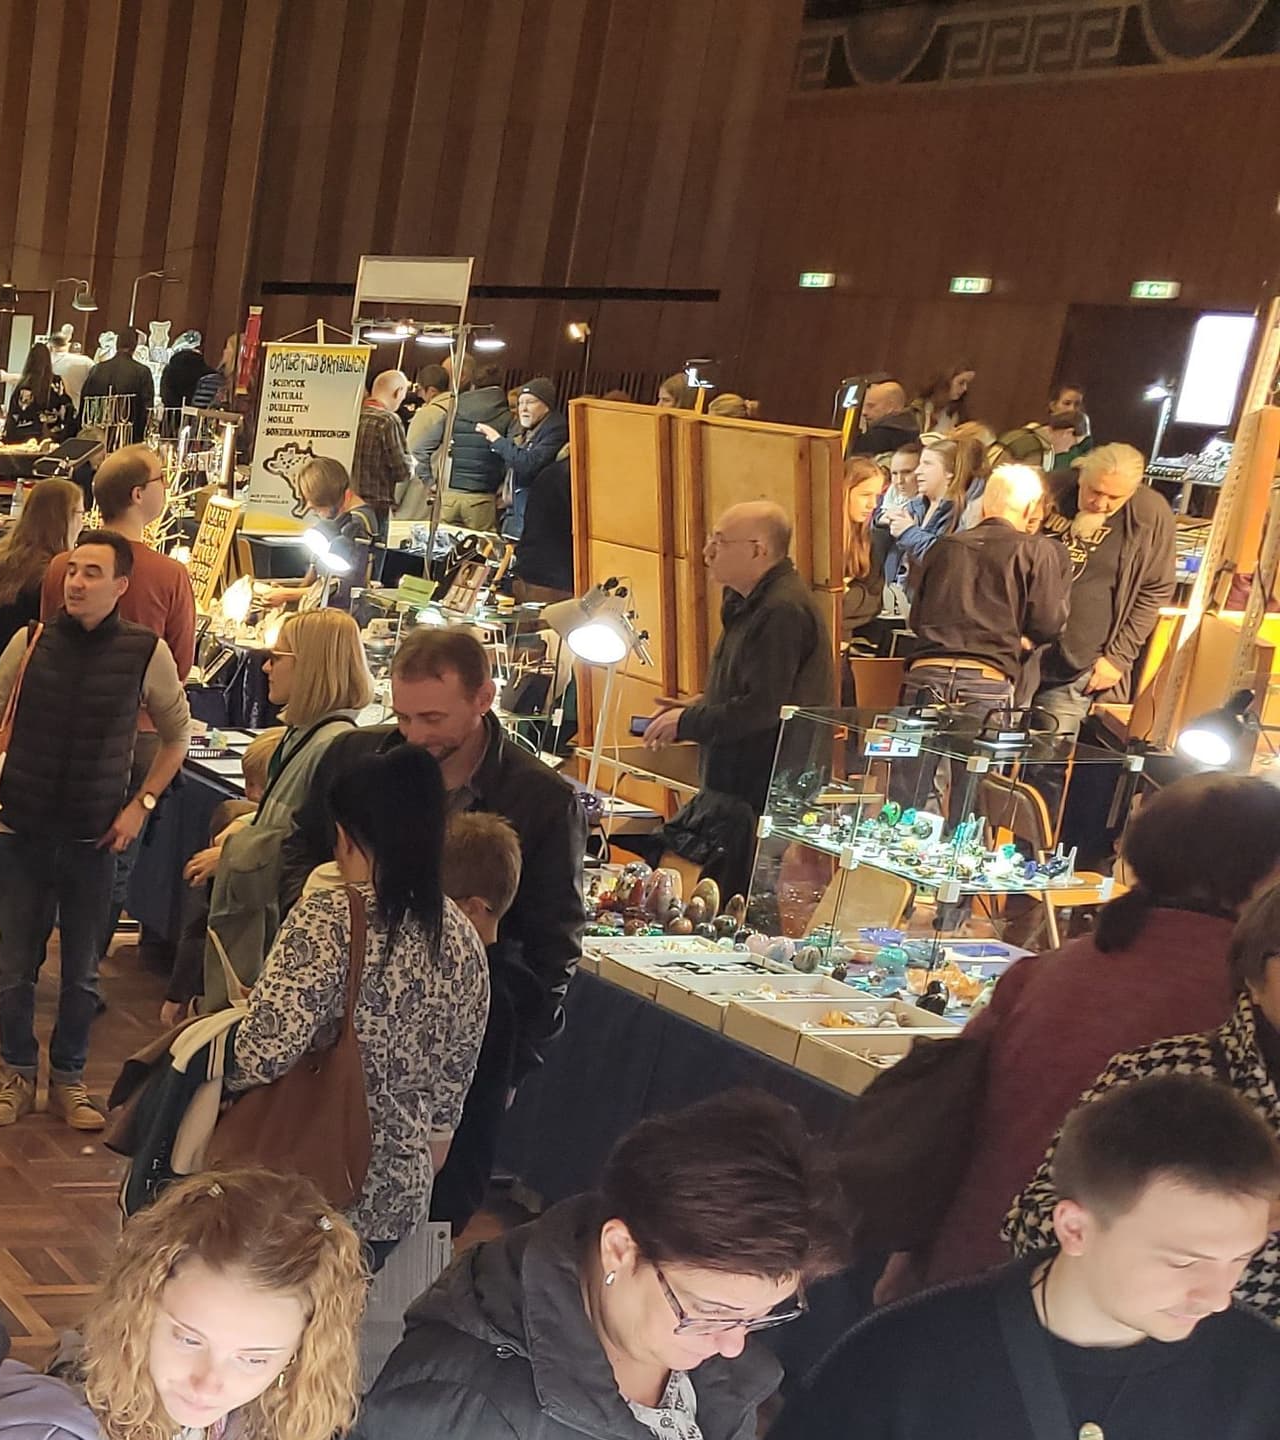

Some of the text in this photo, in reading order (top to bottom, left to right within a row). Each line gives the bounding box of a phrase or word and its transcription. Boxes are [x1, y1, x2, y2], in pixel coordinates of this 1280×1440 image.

[271, 379, 306, 388] SCHMUCK
[270, 391, 304, 400] NATURAL
[268, 403, 309, 412] DUBLETTEN
[267, 416, 294, 424] MOSAIK
